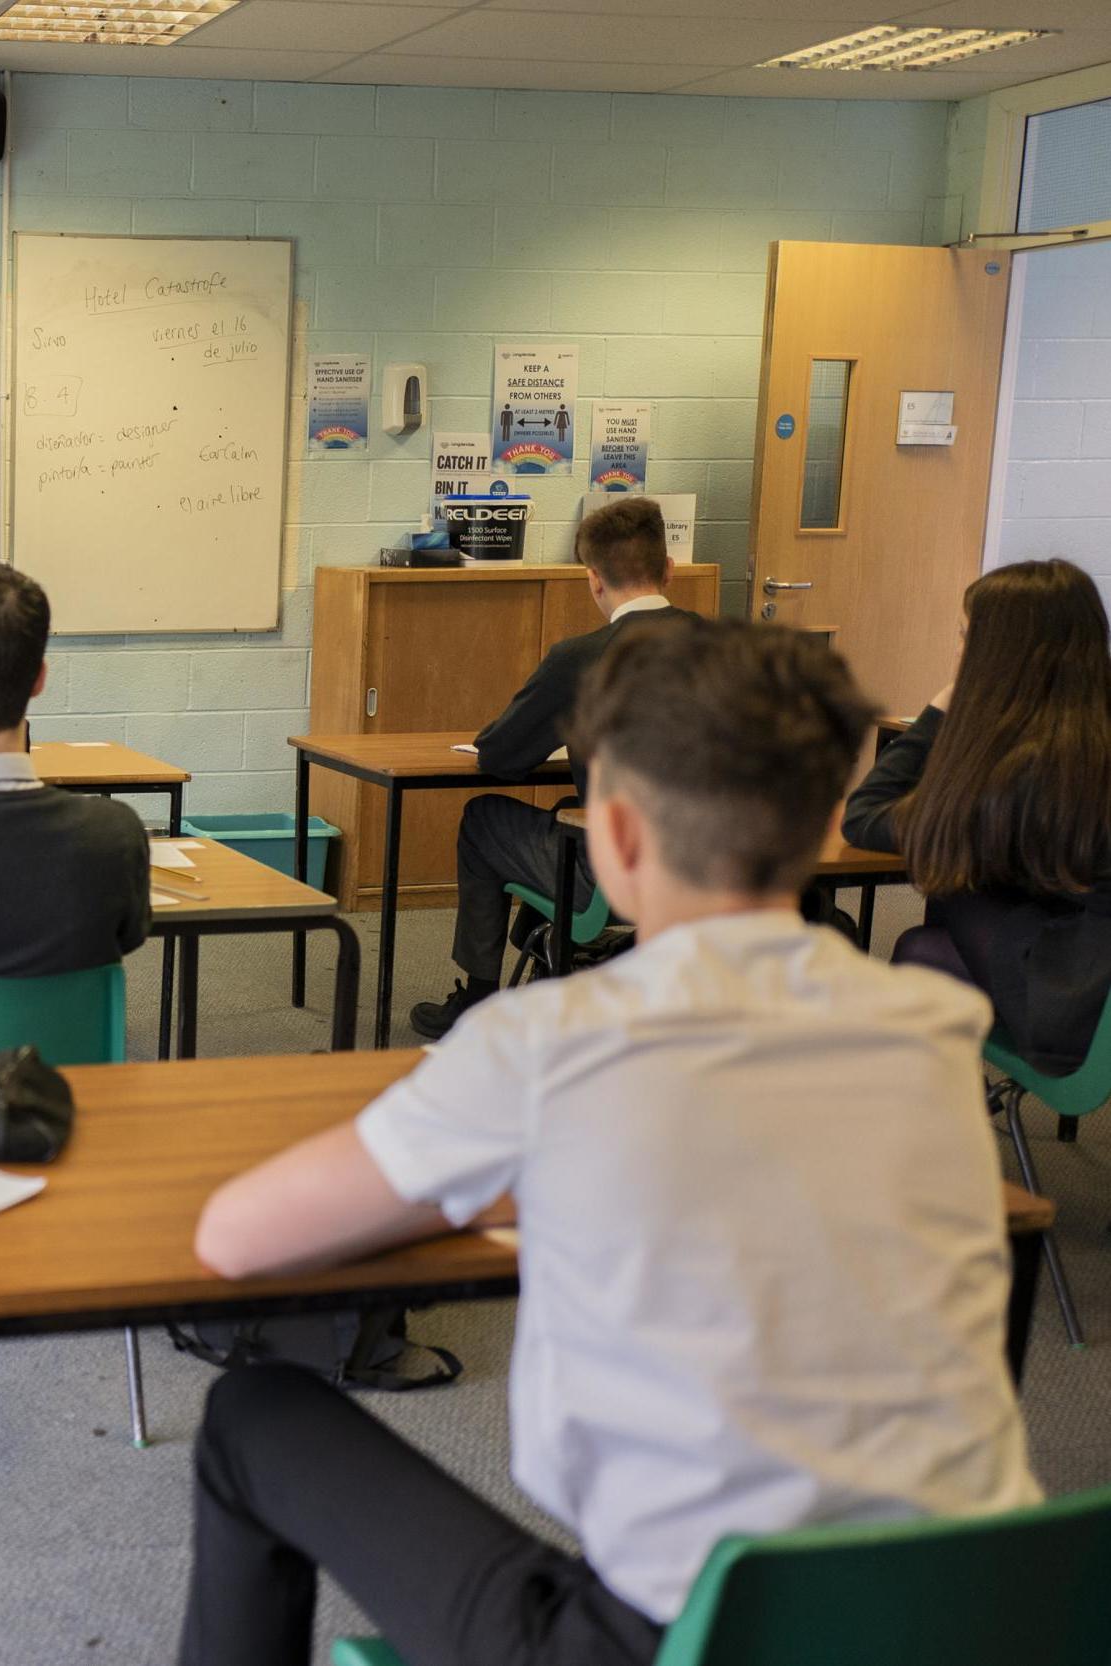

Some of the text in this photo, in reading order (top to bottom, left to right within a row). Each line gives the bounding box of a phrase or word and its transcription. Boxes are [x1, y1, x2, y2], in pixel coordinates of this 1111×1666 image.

[84, 271, 227, 312] Hotel Catastrofe
[151, 315, 248, 343] viernes el 16
[203, 341, 259, 362] de julio
[315, 368, 344, 376] EFFECTIVE
[344, 368, 355, 376] USE
[523, 364, 549, 373] KEEP A
[316, 376, 335, 384] HAND
[507, 378, 565, 387] SAFE DISTANCE
[509, 392, 562, 400] FROM OTHERS
[621, 418, 638, 426] MUST
[116, 419, 178, 448] designer
[506, 443, 556, 458] THANK YOU
[601, 445, 624, 453] BEFORE
[603, 453, 636, 461] LEAVE THIS
[437, 455, 488, 470] CATCH IT
[434, 480, 469, 495] BIN IT
[196, 493, 225, 512] aire
[230, 483, 263, 504] libre
[666, 522, 688, 532] Library
[459, 534, 513, 542] Disinfectant Wipes
